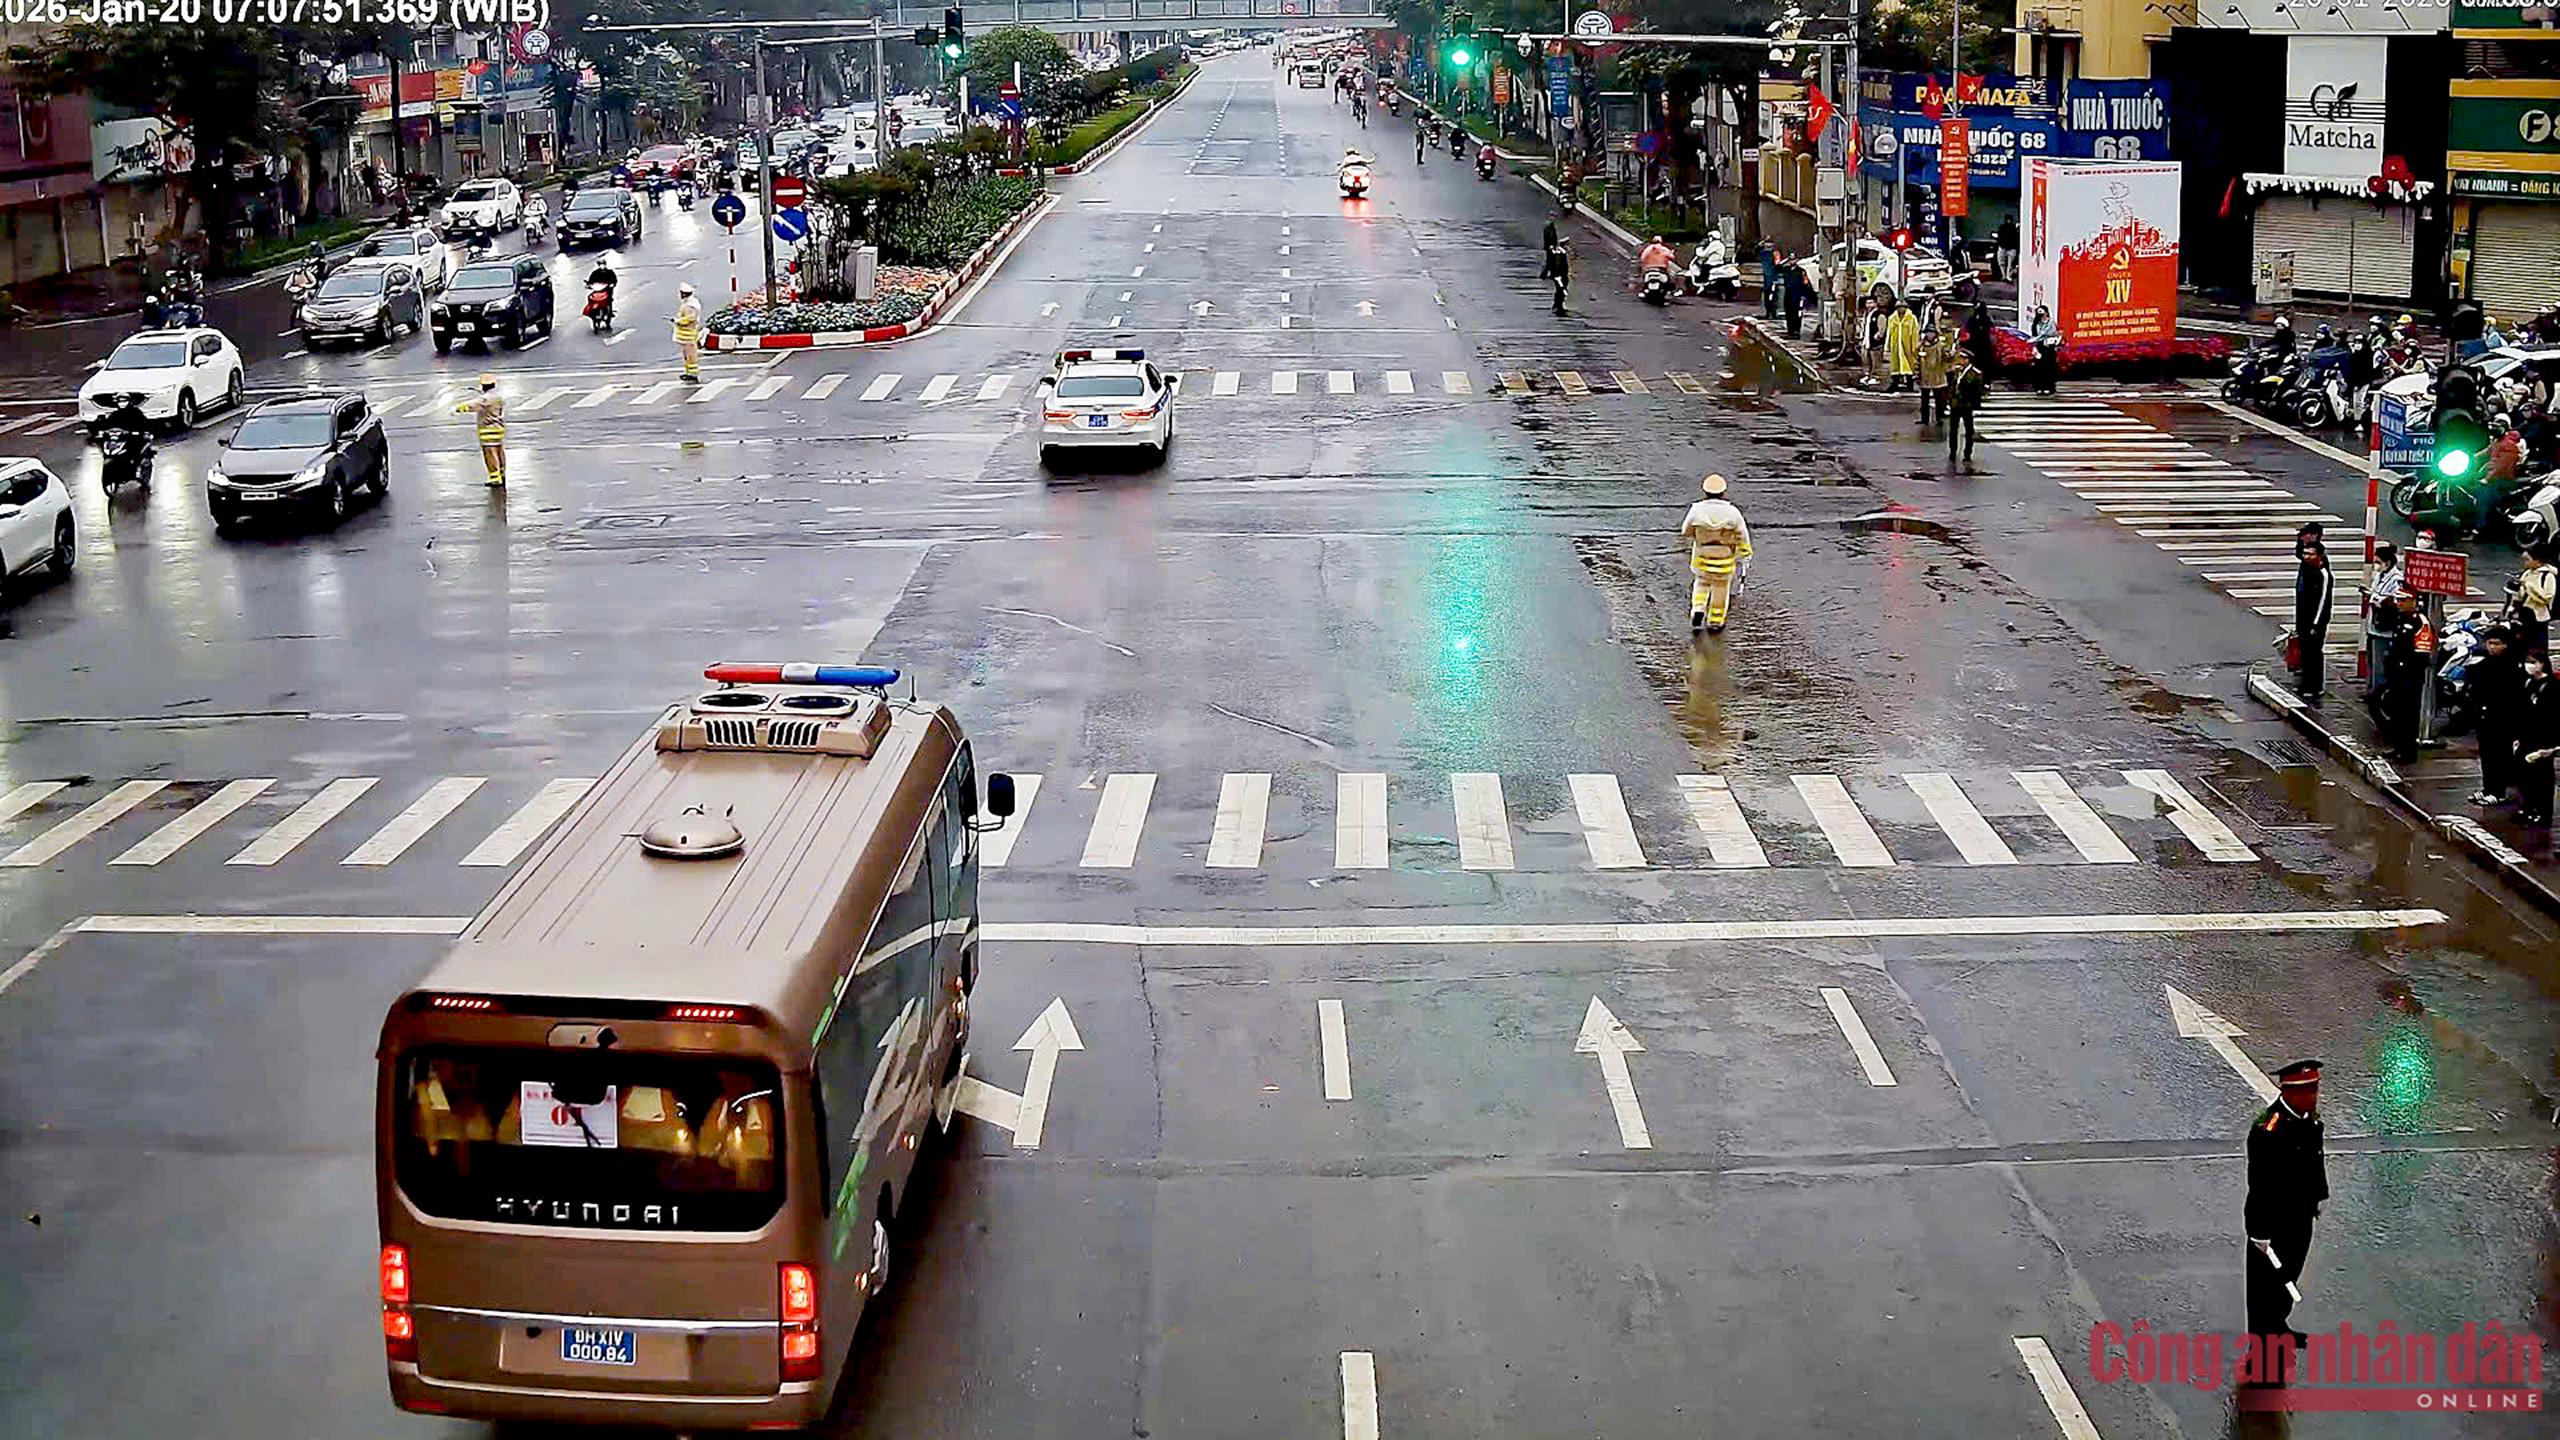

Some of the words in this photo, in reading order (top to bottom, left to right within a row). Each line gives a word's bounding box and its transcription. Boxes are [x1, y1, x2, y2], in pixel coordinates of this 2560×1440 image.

[2072, 91, 2108, 130] NHÀ
[2110, 87, 2163, 130] THUỐC
[1903, 124, 1943, 145] NHÀ
[2020, 131, 2046, 149] 68
[2094, 135, 2141, 160] 68
[2288, 123, 2377, 149] Matcha
[2105, 279, 2132, 304] XIV
[495, 1196, 679, 1225] HYUNDAI
[598, 1330, 624, 1347] XIV
[570, 1344, 627, 1362] 000.84
